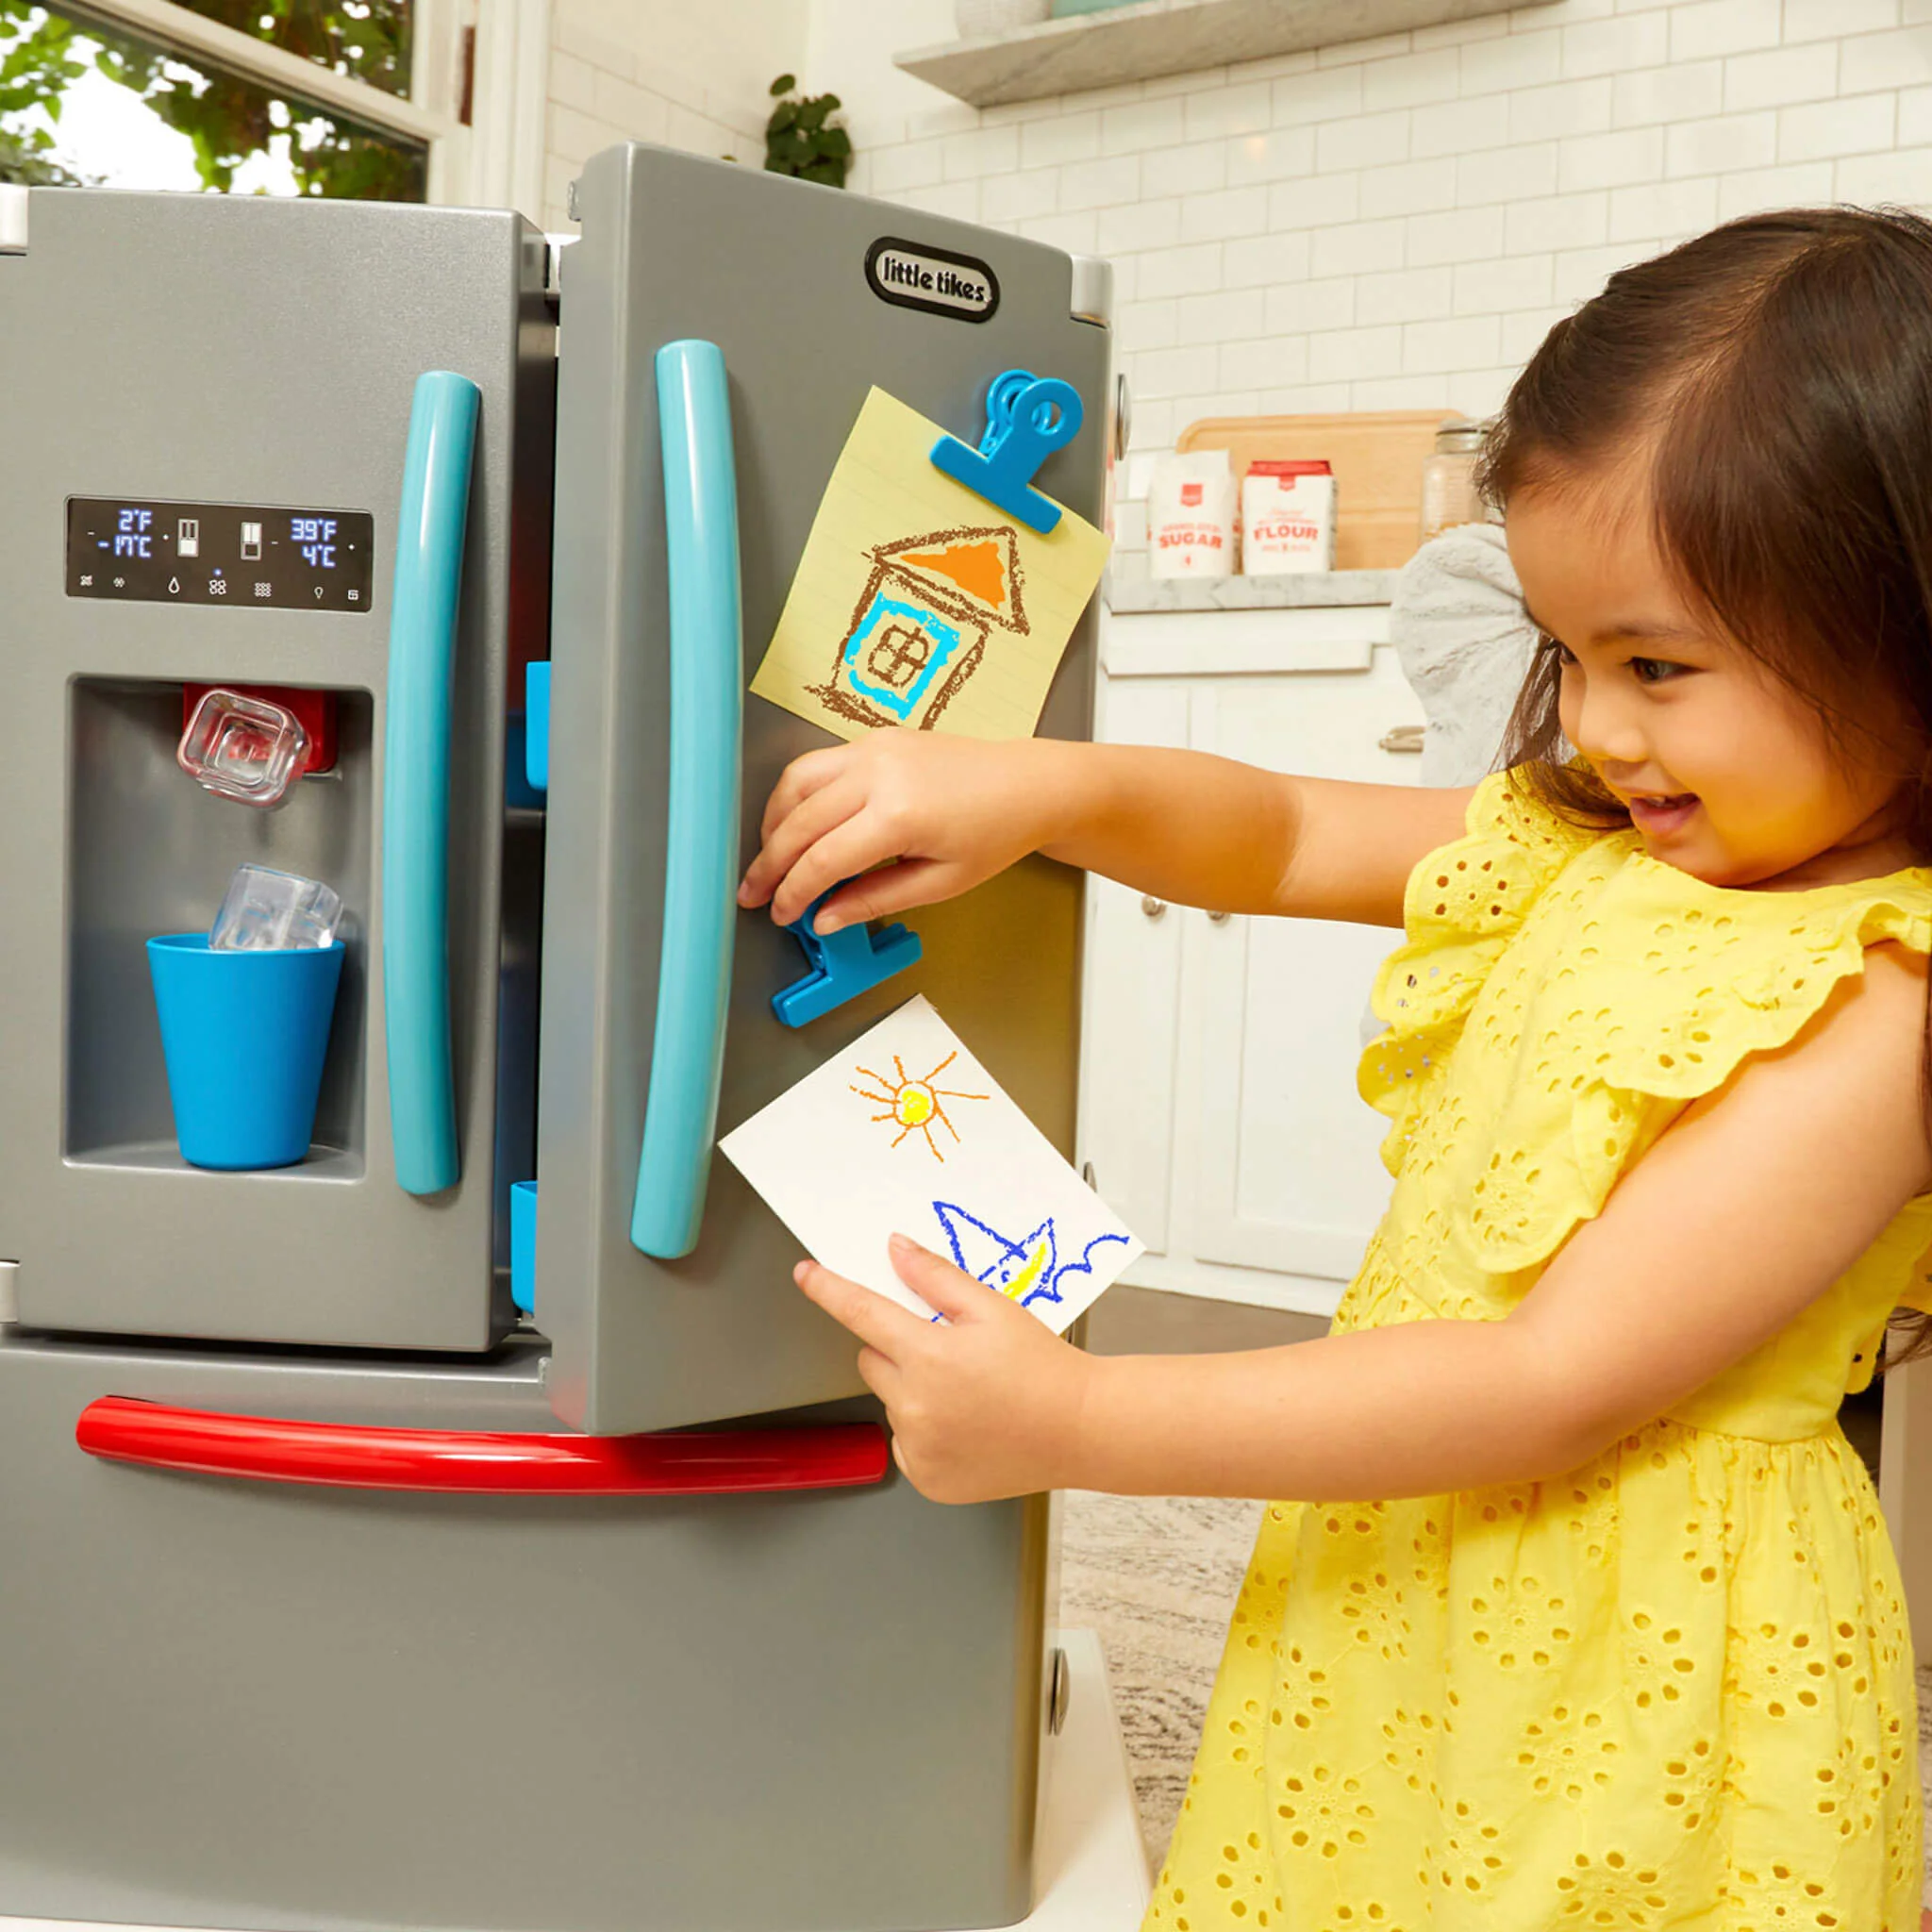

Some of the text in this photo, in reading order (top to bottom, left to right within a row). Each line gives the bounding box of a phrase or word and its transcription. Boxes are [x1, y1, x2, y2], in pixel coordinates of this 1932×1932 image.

[883, 256, 985, 302] little tikes
[1158, 531, 1223, 549] SUGAR
[1253, 525, 1319, 541] FLOUR
